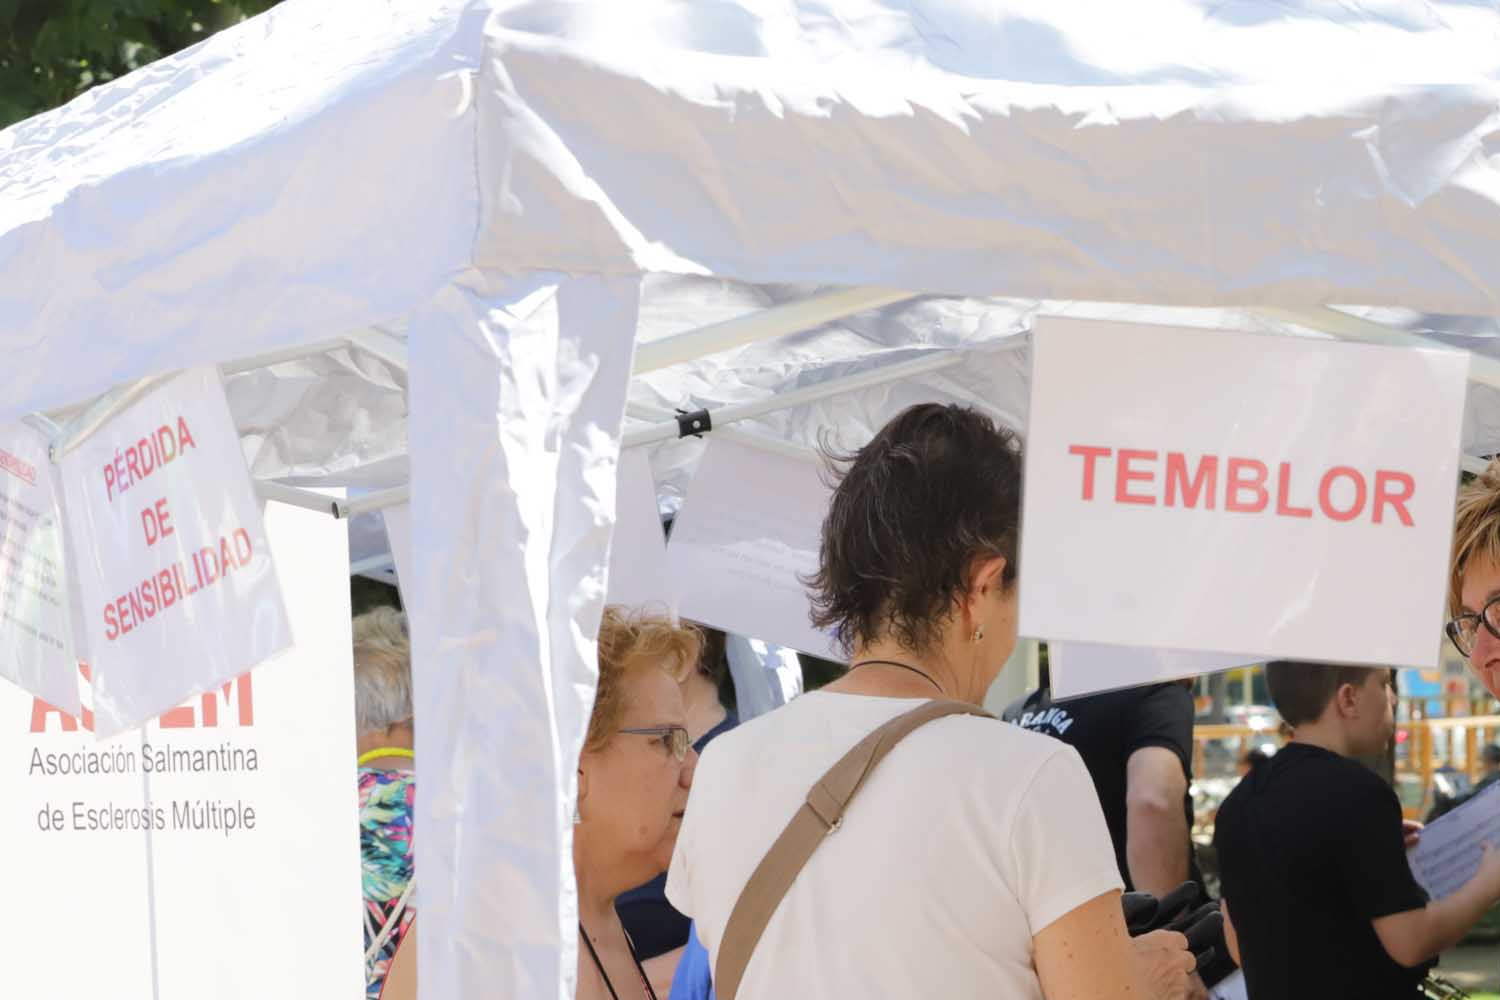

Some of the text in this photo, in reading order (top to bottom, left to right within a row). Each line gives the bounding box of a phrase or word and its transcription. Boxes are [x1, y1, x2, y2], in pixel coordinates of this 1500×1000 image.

[103, 416, 196, 502] PÉRDIDA
[1068, 444, 1416, 527] TEMBLOR
[141, 497, 174, 546] DE
[103, 527, 254, 641] SENSIBILIDAD
[29, 742, 259, 776] Asociación Salmantina
[38, 799, 256, 836] de Esclerosis Múltiple
